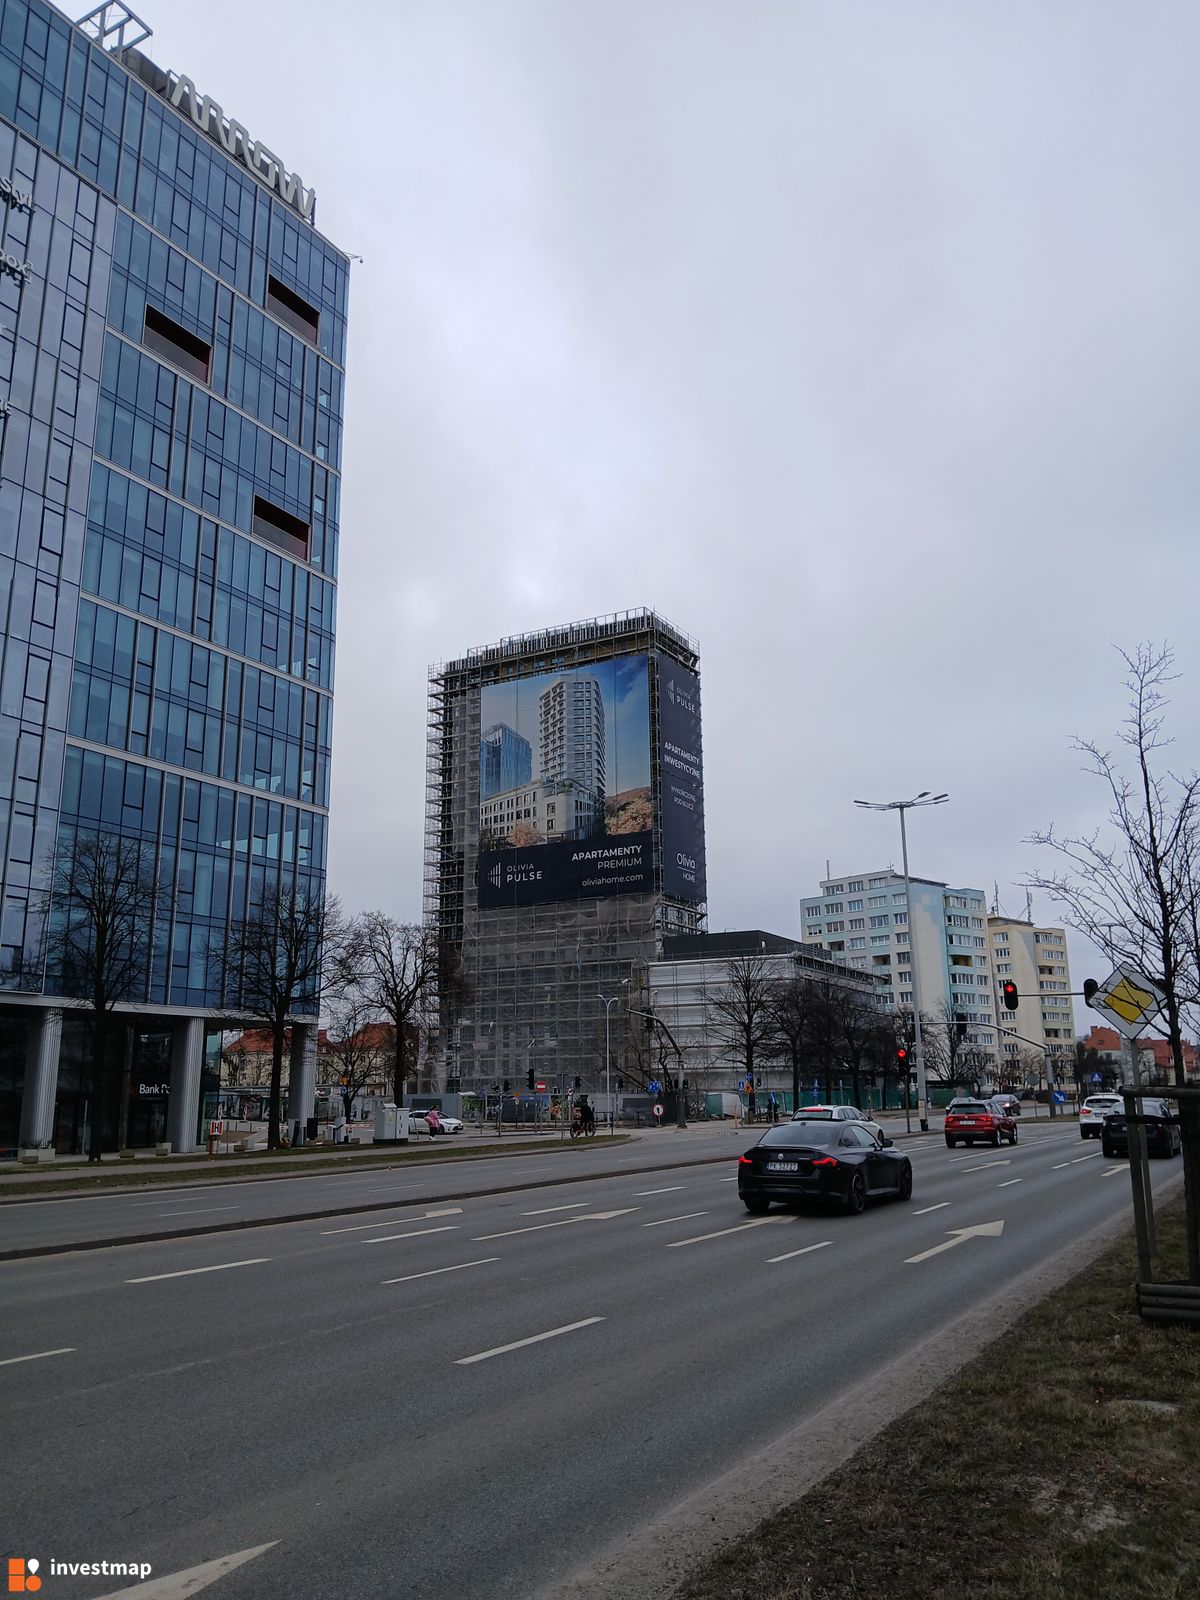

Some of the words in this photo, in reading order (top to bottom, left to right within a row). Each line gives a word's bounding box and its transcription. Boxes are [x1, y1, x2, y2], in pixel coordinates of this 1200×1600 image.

[676, 695, 695, 713] PULSE
[664, 741, 699, 764] APARTAMENTY
[571, 844, 643, 862] APARTAMENTY
[506, 863, 535, 873] OLIVIA
[597, 857, 643, 871] PREMIUM
[676, 853, 697, 871] Olivia
[506, 870, 543, 883] PULSE
[581, 874, 644, 888] oliviahome.com
[682, 872, 697, 884] HOME
[139, 1084, 159, 1094] Bank
